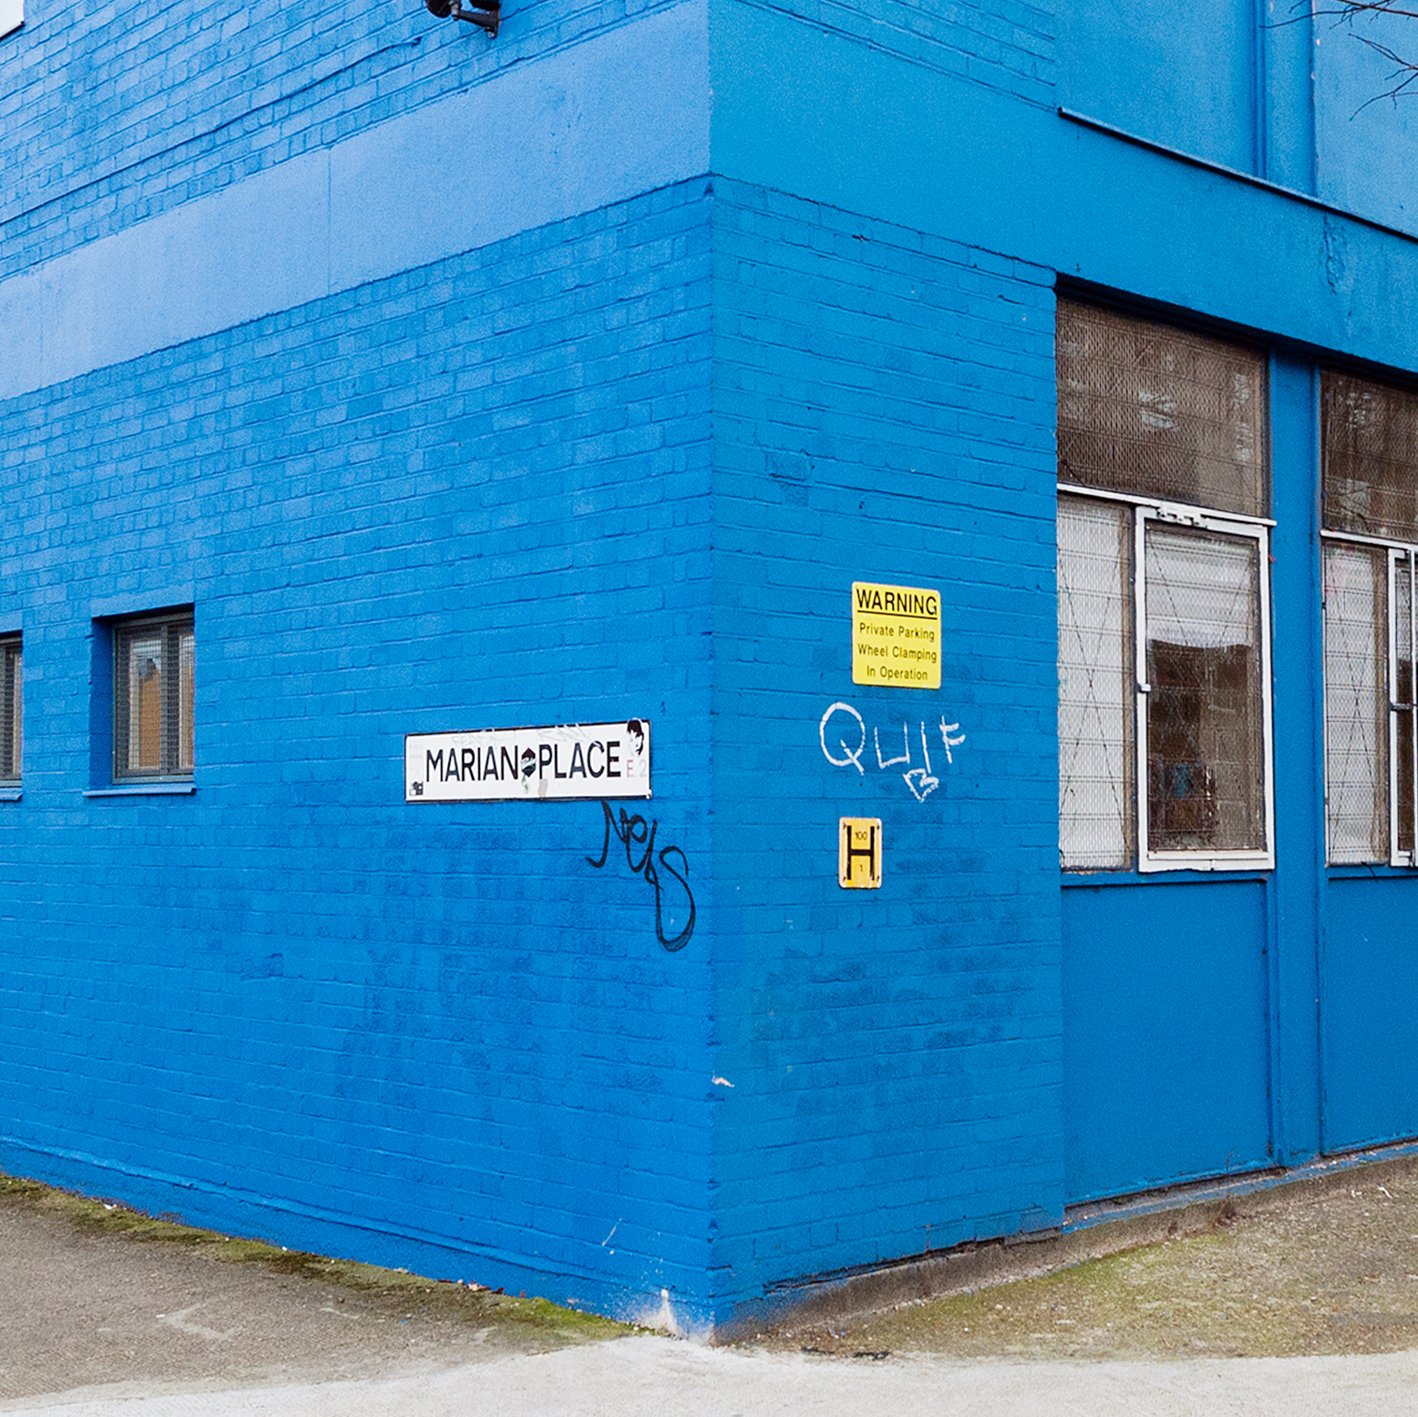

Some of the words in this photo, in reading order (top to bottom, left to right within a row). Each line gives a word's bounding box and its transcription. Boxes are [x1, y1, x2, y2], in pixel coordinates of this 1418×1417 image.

[856, 588, 937, 615] WARNING
[859, 622, 894, 637] Private
[898, 626, 935, 642] Parking
[858, 643, 888, 657] Wheel
[892, 646, 937, 663] Clamping
[867, 665, 876, 677] In
[880, 666, 928, 681] Operation
[426, 745, 518, 782] MARIAN
[538, 740, 621, 779] PLACE
[854, 831, 868, 841] 100
[847, 825, 875, 881] H
[859, 864, 864, 873] 1
